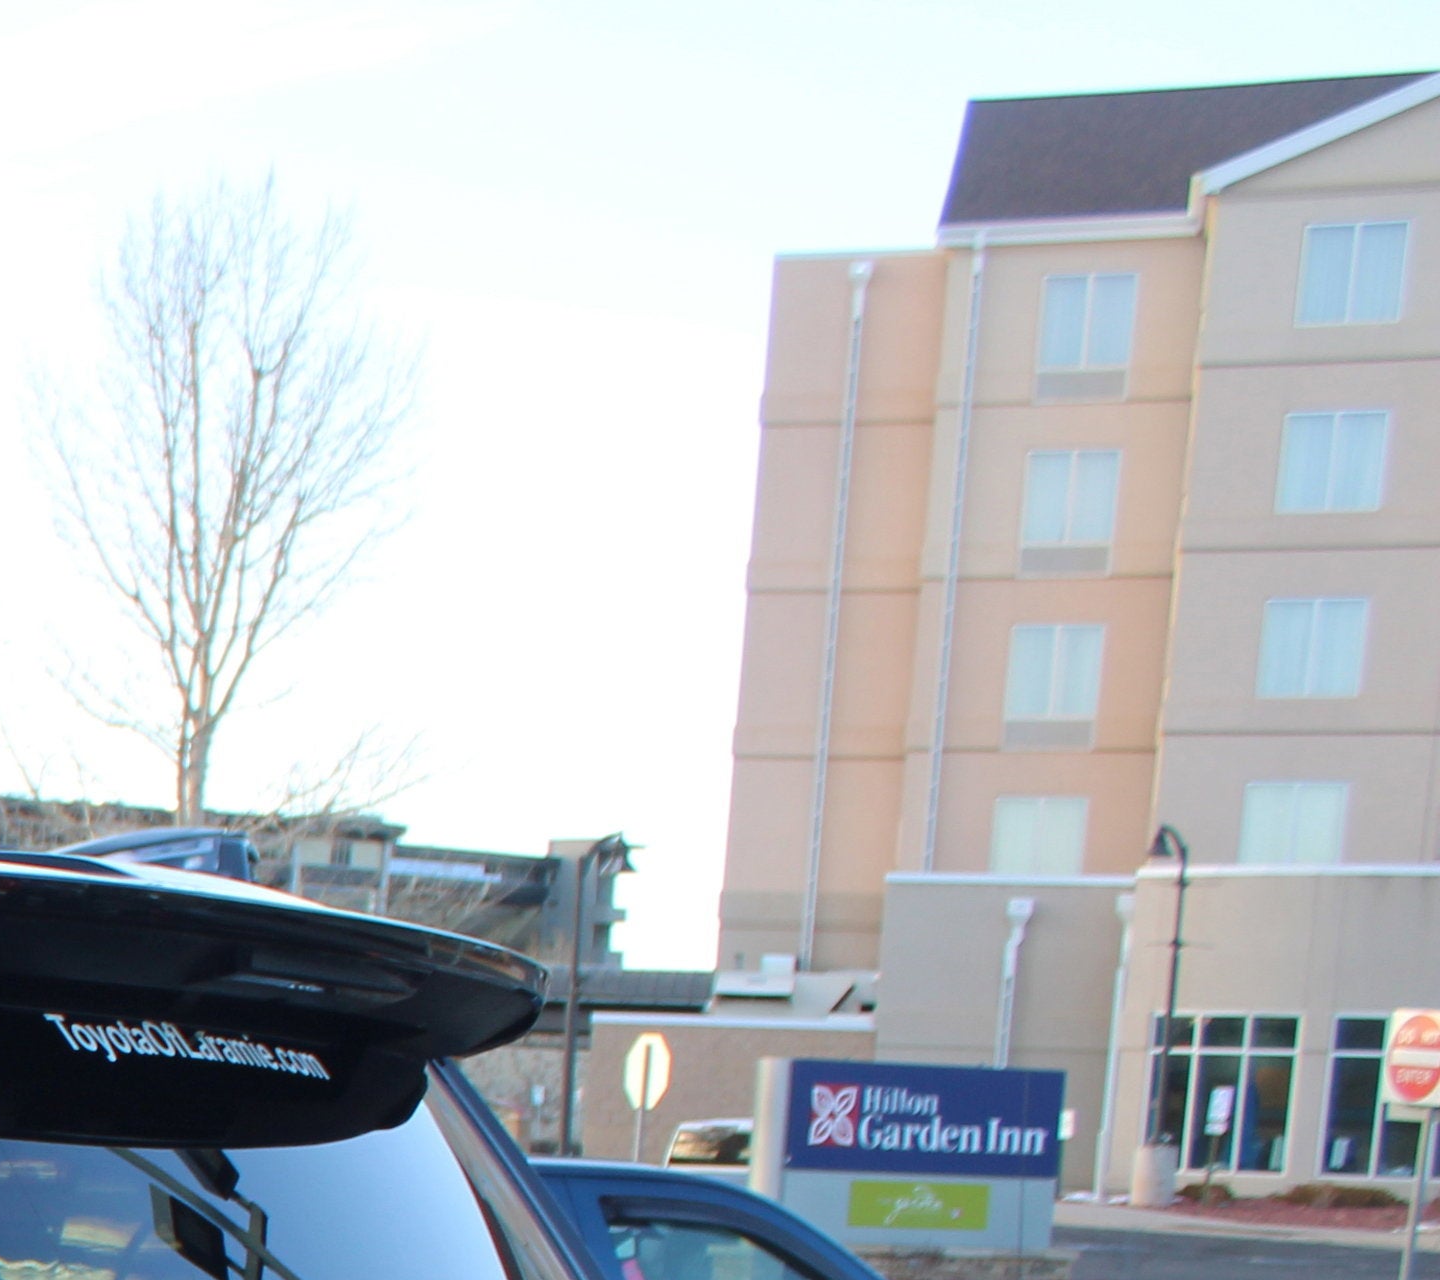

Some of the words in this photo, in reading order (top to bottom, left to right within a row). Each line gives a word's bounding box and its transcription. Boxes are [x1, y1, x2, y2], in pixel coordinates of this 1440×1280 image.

[44, 1013, 331, 1080] ToyotaOfLaramie.com
[859, 1085, 940, 1116] Hilton
[857, 1112, 982, 1154] Garden
[984, 1116, 1049, 1155] Inn
